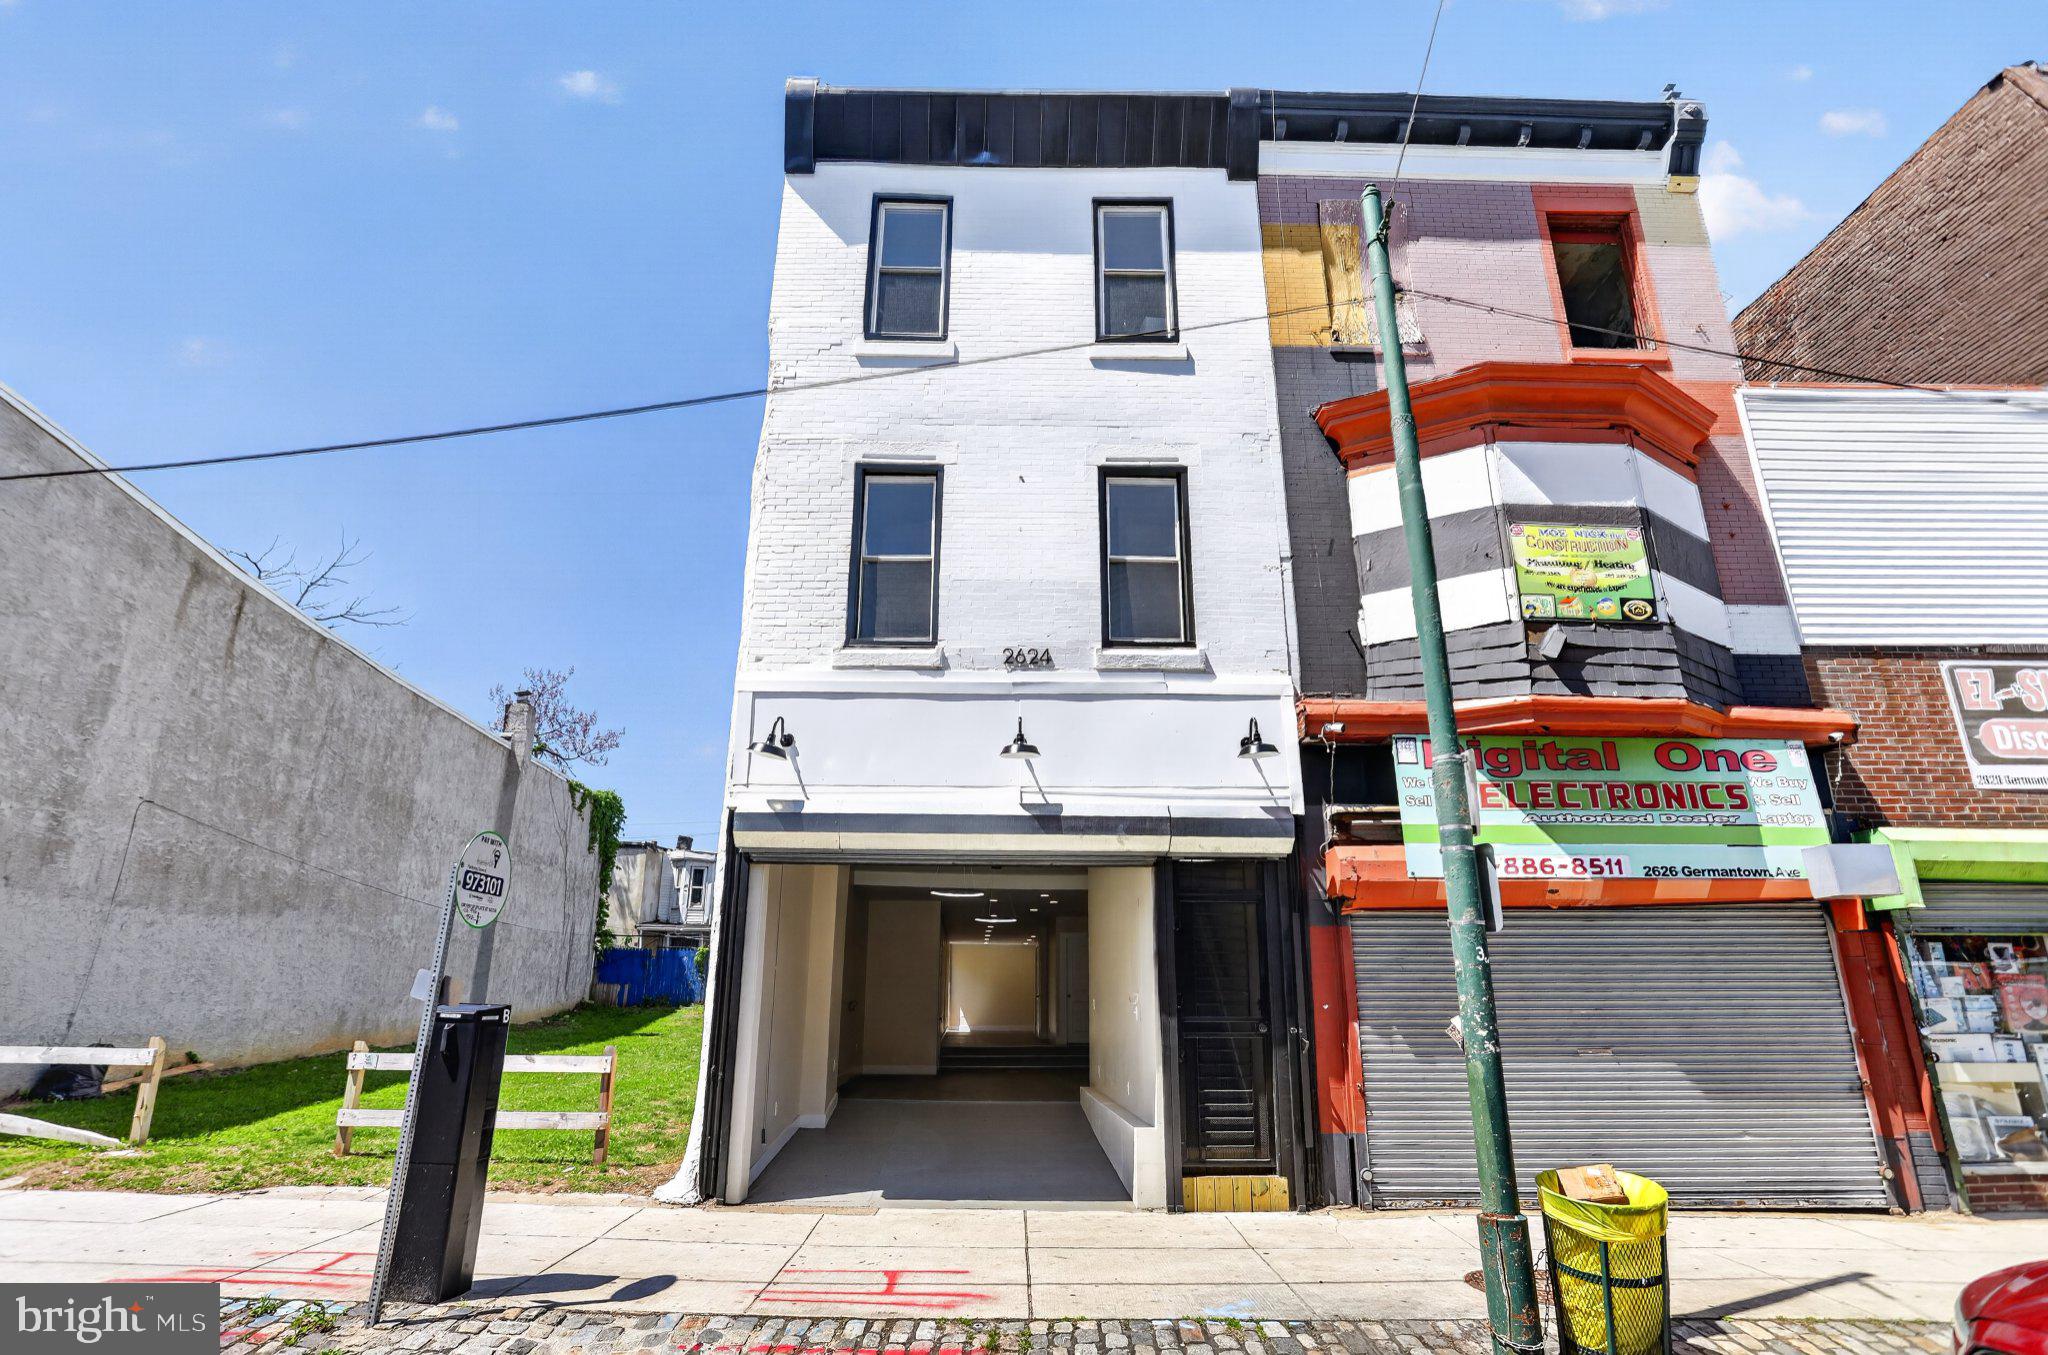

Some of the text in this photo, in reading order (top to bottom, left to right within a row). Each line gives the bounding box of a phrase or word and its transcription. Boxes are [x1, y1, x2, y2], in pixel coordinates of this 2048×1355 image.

[1526, 534, 1629, 553] CONSTRUCTION
[1594, 560, 1636, 571] Heating
[1003, 648, 1052, 665] 2624
[1954, 668, 2048, 711] EZ-S
[1421, 738, 1620, 778] igital
[1655, 741, 1778, 772] One
[1402, 777, 1425, 789] We
[1749, 776, 1808, 789] We Buy
[1405, 795, 1432, 806] Sell
[1478, 780, 1750, 810] ELECTRONICS
[1769, 793, 1801, 806] Sell
[1522, 812, 1741, 824] Authorized Dealer
[1757, 813, 1815, 826] Laptop
[1497, 857, 1624, 875] 886-8511
[1643, 865, 1678, 877] 2626
[1776, 867, 1801, 878] Ave
[466, 872, 501, 896] 973101
[503, 1009, 511, 1024] B
